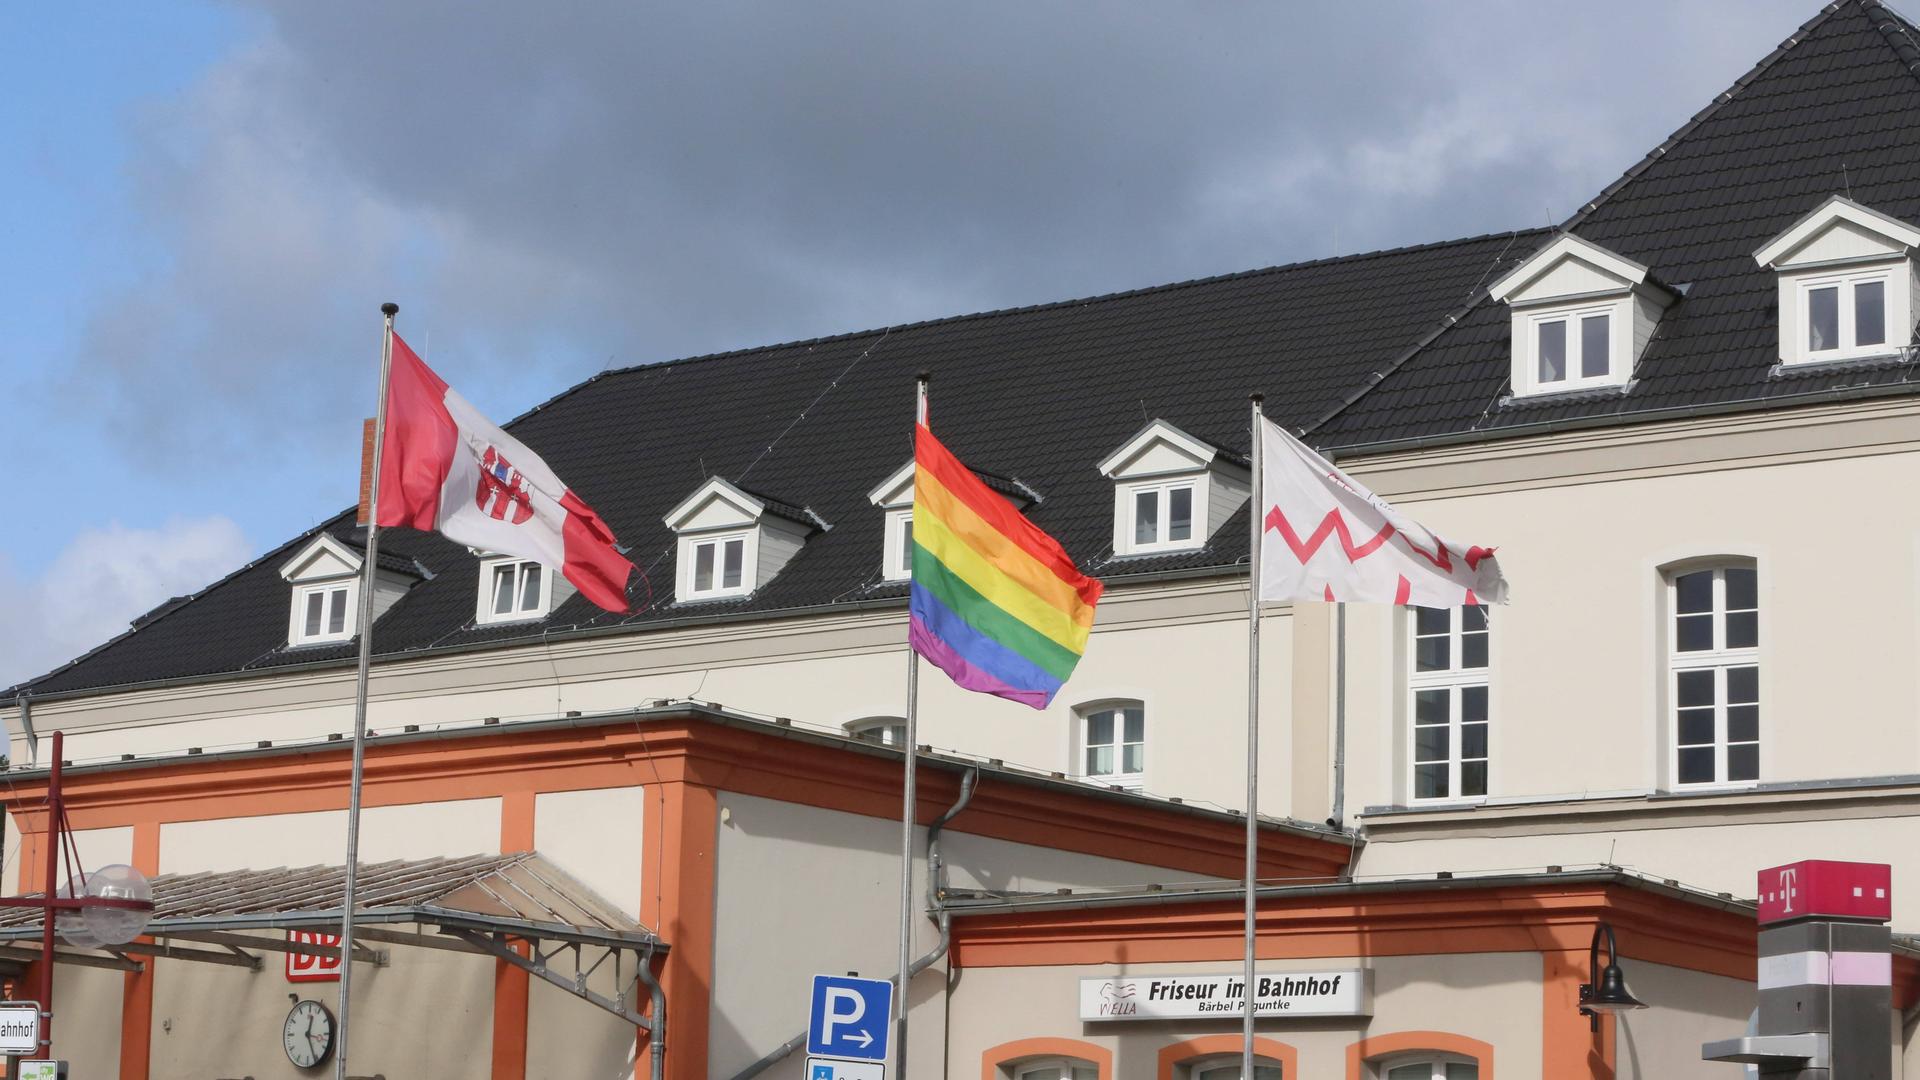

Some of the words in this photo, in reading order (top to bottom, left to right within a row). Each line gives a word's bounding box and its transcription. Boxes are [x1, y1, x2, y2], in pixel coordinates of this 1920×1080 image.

[1780, 868, 1796, 913] T
[294, 929, 342, 970] DB
[1149, 980, 1217, 1001] Friseur
[1258, 975, 1341, 997] Bahnhof
[822, 986, 866, 1046] P
[1100, 1002, 1136, 1016] WELLA
[1198, 1000, 1234, 1012] Bärbel
[1238, 999, 1290, 1013] Pguntke
[0, 1020, 34, 1038] ahnhof
